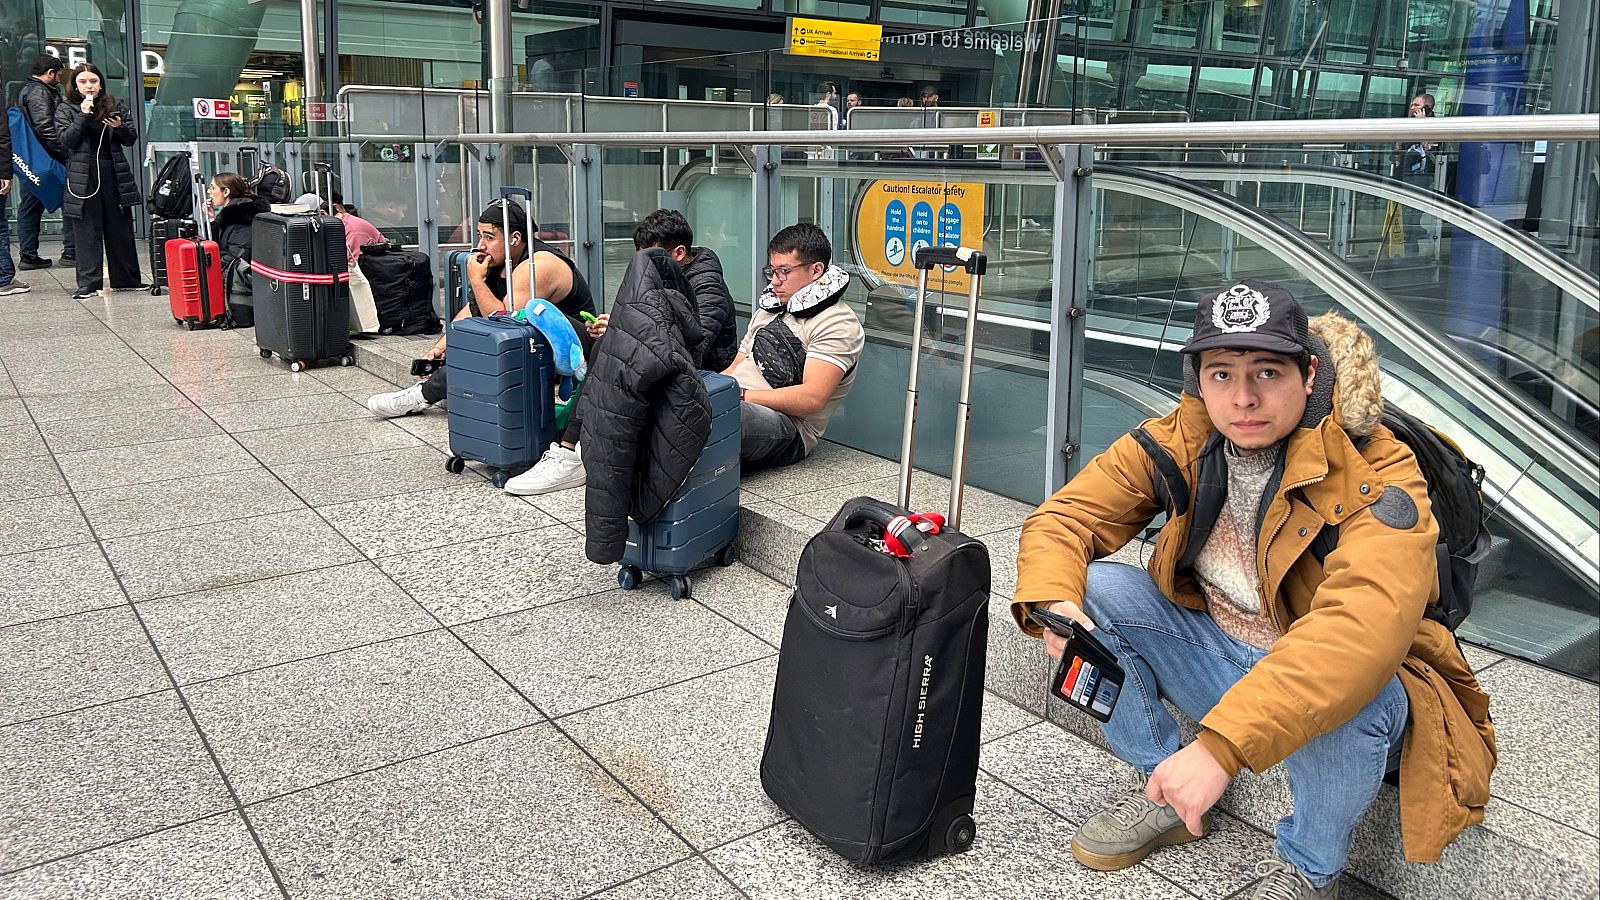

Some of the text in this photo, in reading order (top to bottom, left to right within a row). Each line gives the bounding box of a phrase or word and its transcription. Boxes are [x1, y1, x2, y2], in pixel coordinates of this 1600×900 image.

[818, 47, 849, 56] International
[882, 183, 966, 198] Caution! Escalator safety
[886, 224, 905, 232] handrail
[912, 713, 925, 748] HIGH
